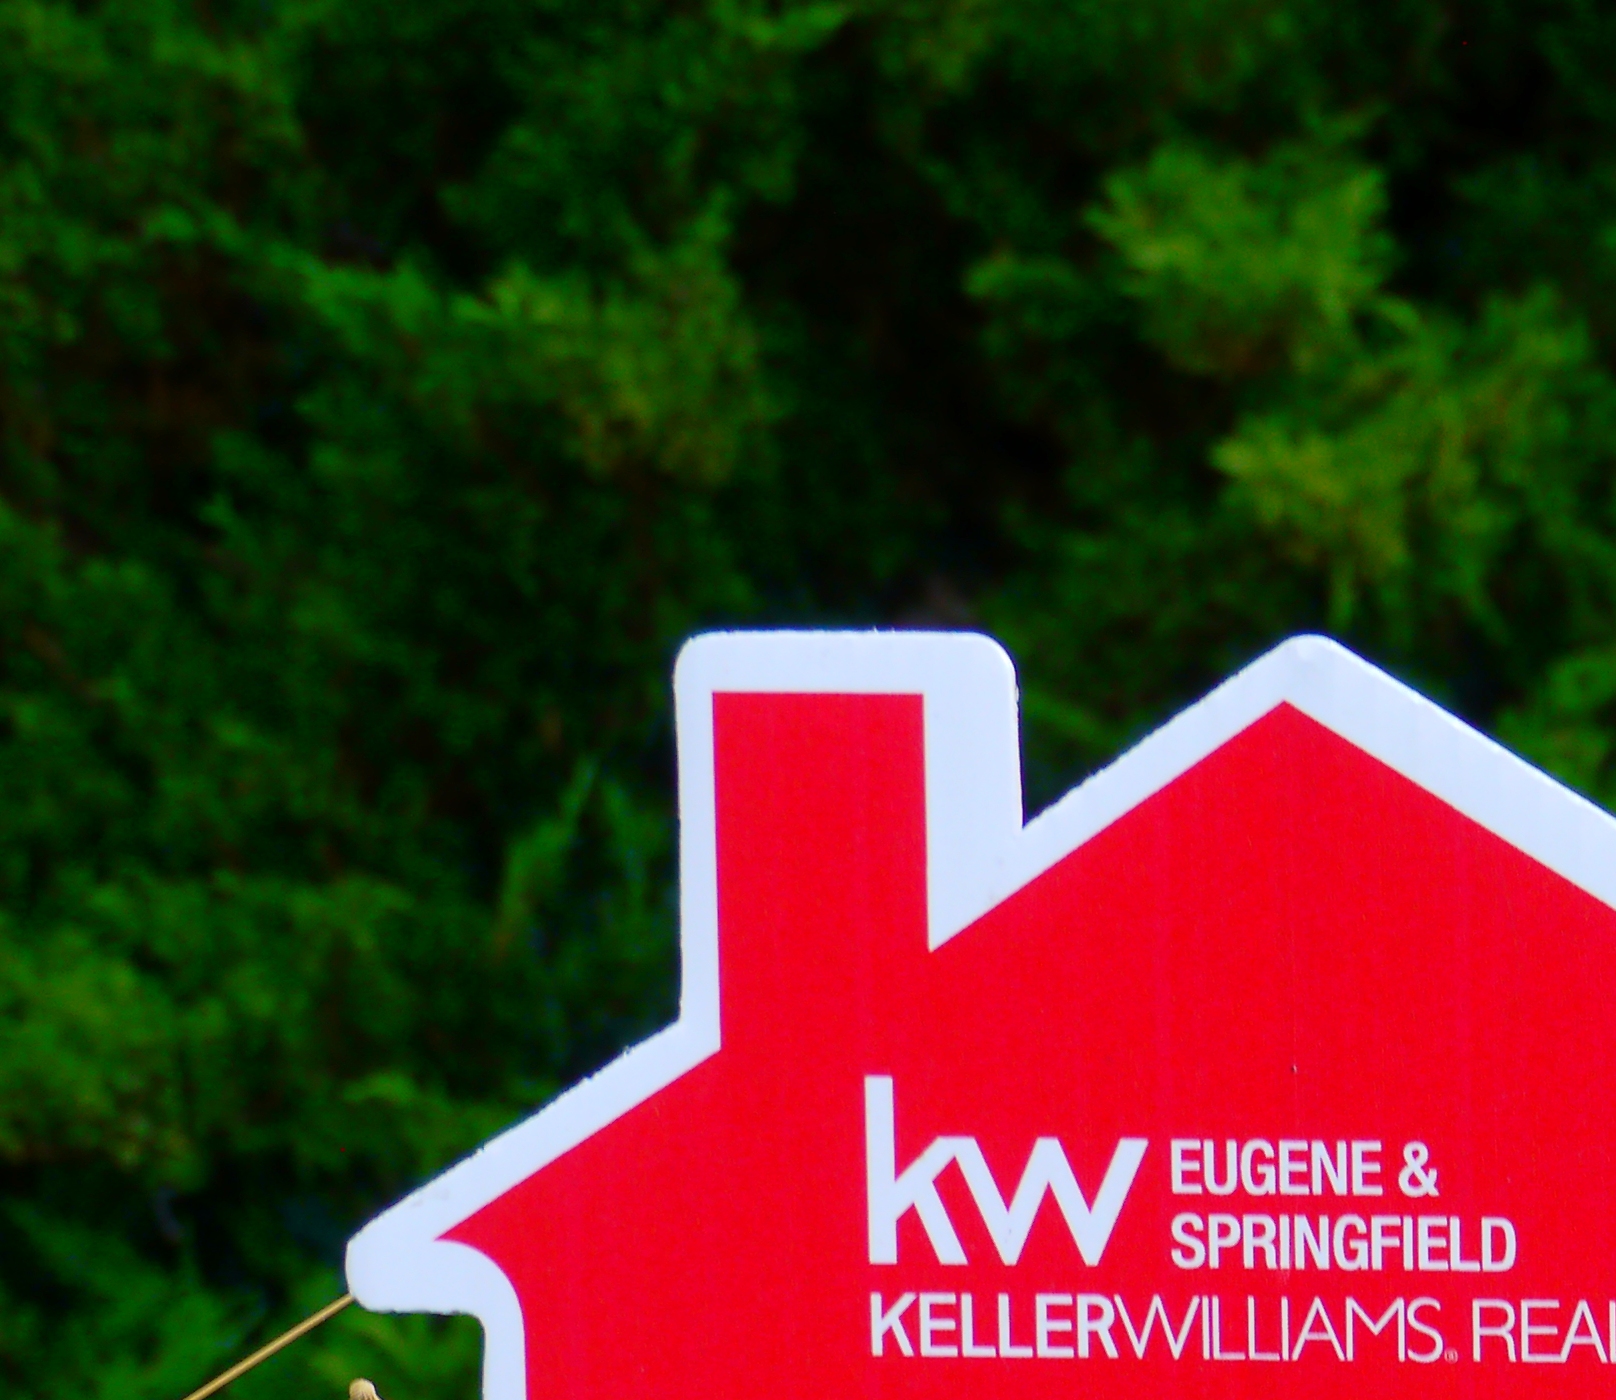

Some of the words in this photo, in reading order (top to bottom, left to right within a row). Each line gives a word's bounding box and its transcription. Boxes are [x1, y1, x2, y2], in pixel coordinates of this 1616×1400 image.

[865, 1075, 1148, 1267] kw
[1170, 1139, 1383, 1196] EUGENE
[1398, 1141, 1439, 1198] &
[1171, 1212, 1517, 1272] SPRINGFIELD
